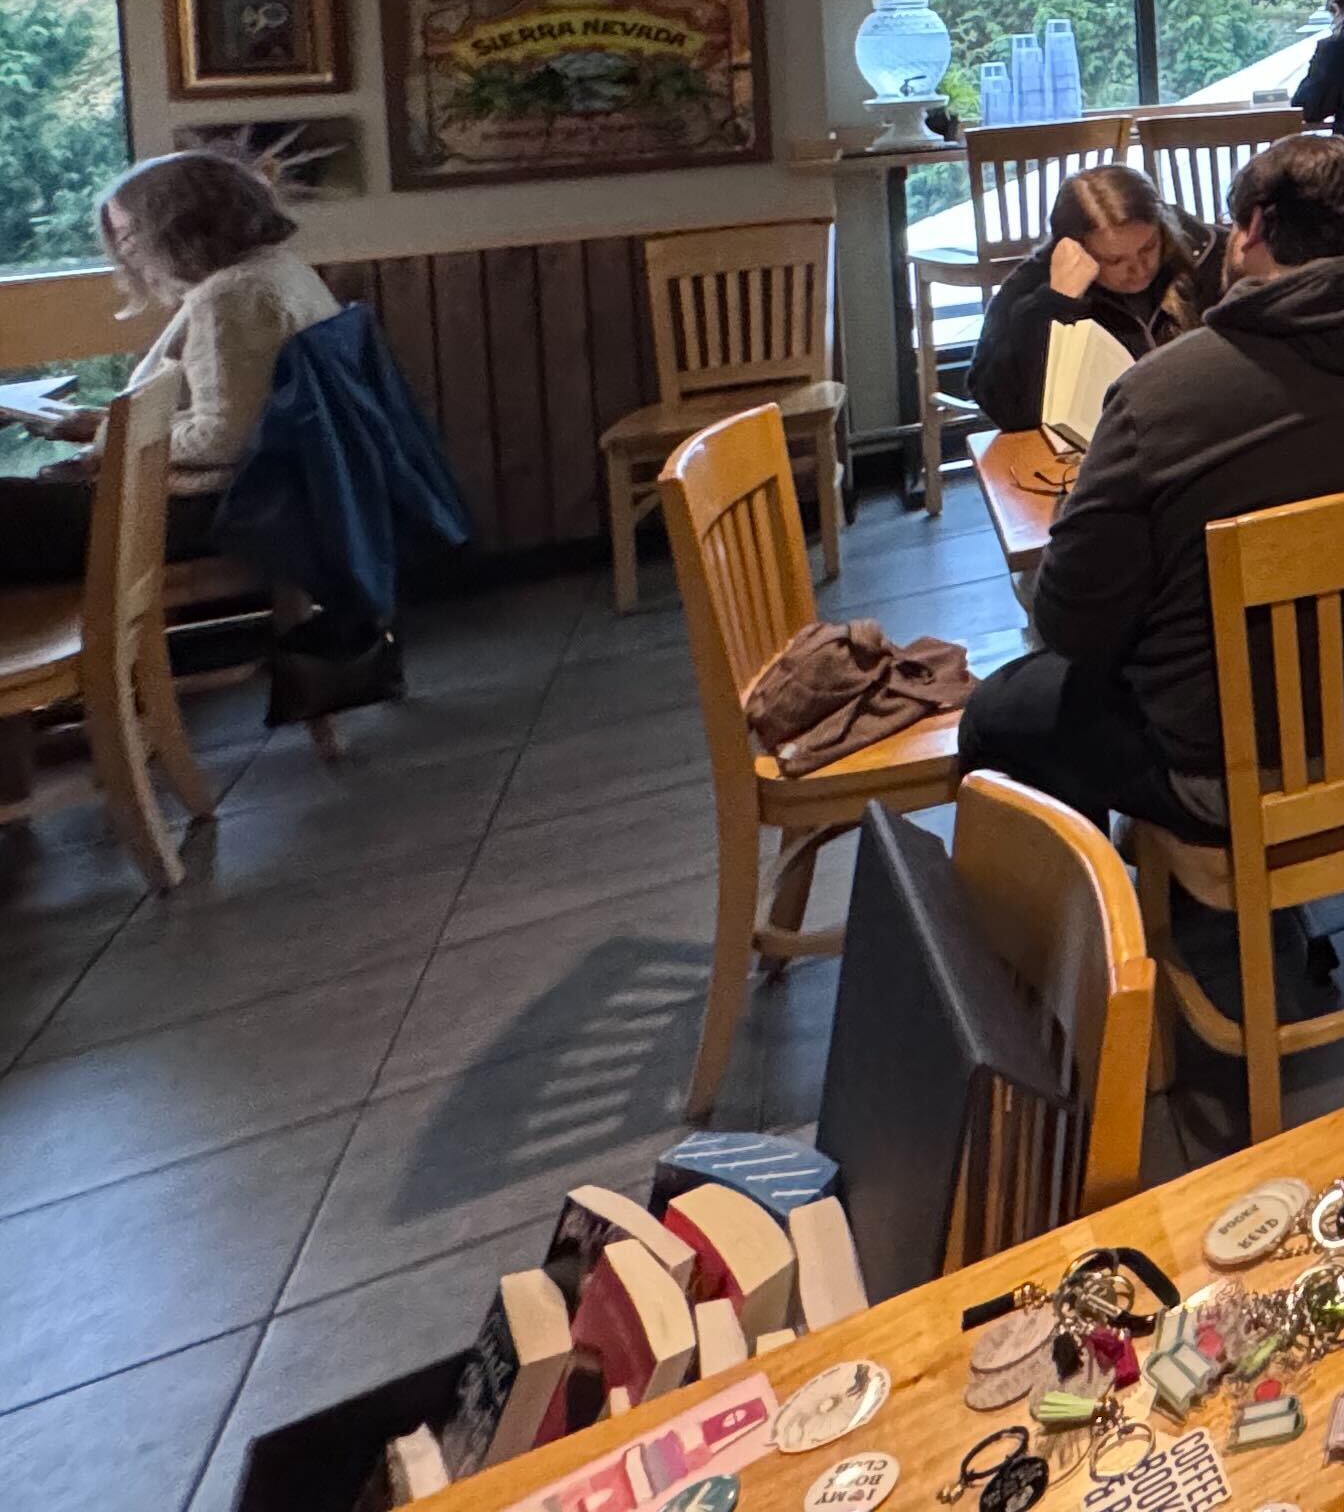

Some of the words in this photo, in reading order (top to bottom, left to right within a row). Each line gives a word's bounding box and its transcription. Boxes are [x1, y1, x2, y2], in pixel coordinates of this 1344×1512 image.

[471, 19, 577, 56] SIERRA
[582, 17, 689, 47] NEVADA
[824, 1474, 884, 1490] BOK
[1127, 1451, 1186, 1512] BOOK
[1170, 1431, 1228, 1512] COFFEE
[814, 1490, 848, 1506] MY
